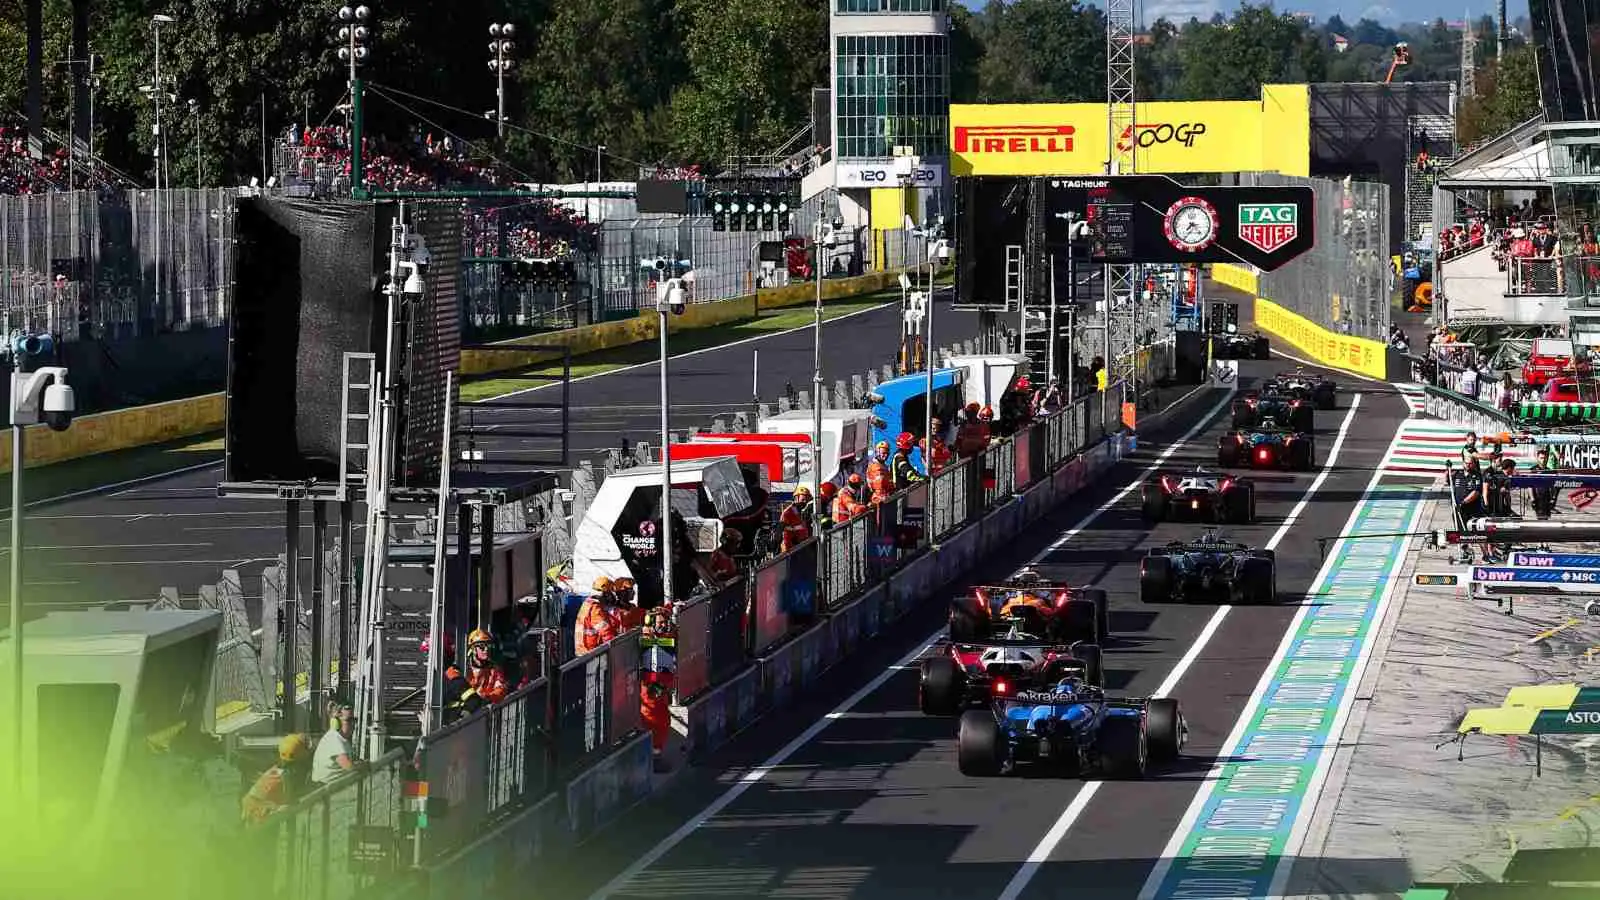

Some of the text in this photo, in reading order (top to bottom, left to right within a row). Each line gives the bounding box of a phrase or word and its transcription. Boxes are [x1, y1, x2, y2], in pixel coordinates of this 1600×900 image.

[954, 125, 1076, 152] PIRELLI
[860, 170, 887, 181] 120
[1243, 207, 1292, 222] TAG
[1242, 225, 1294, 249] HEUER
[1529, 556, 1555, 566] BWT
[1488, 570, 1597, 582] BWT MSC
[1565, 711, 1600, 724] ASTO
